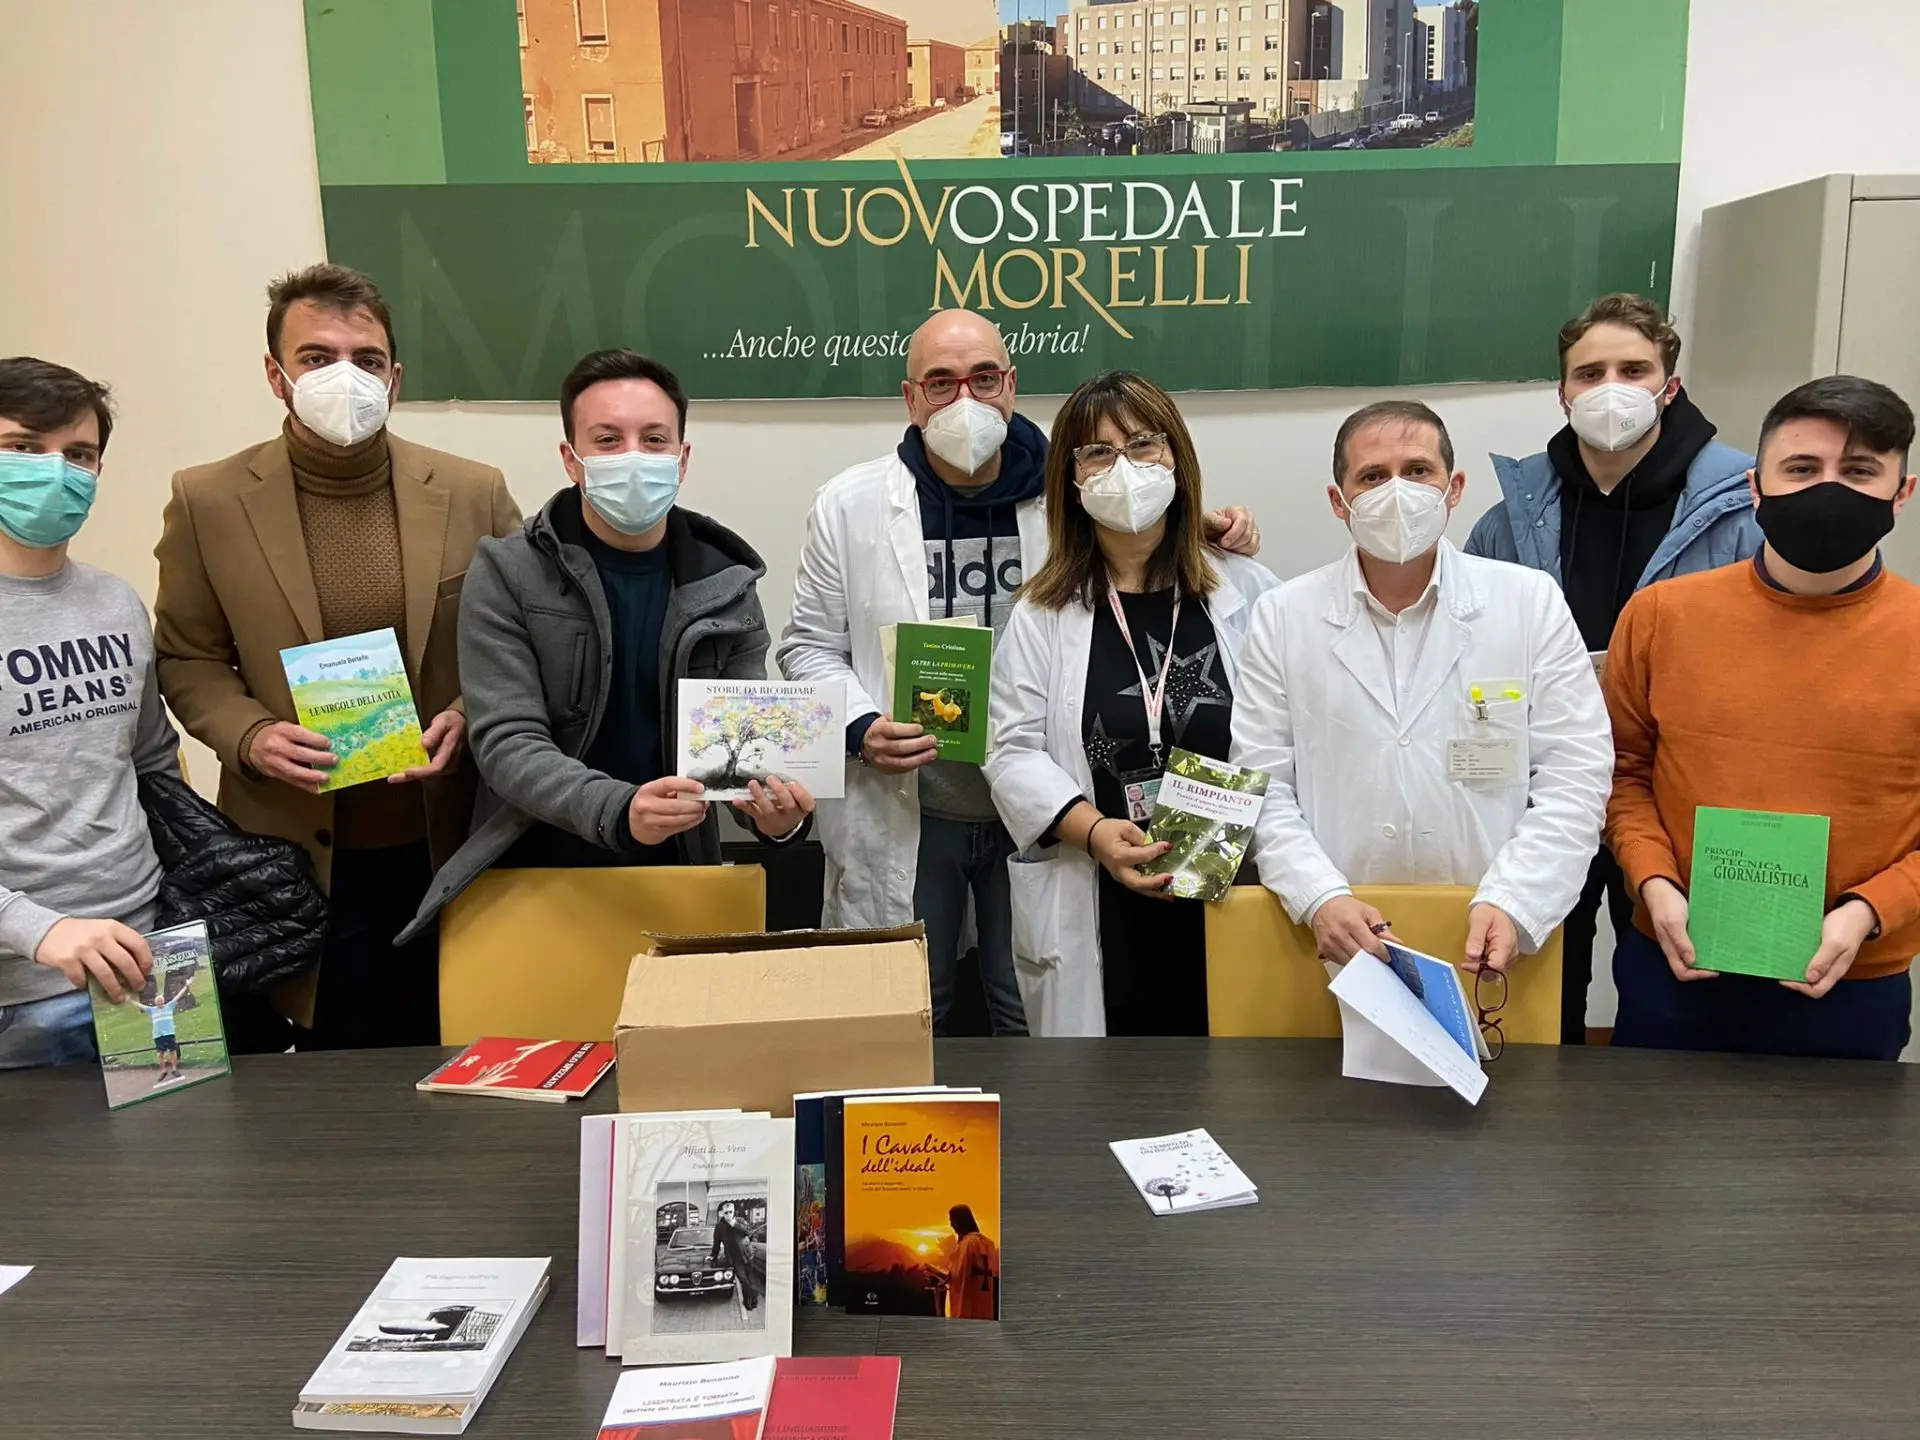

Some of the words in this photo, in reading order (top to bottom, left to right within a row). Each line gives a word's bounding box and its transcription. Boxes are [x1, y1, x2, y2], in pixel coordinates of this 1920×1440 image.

[928, 242, 1253, 340] MORELLI
[0, 633, 134, 687] OMMY
[320, 697, 356, 714] VIRGOLE
[356, 693, 382, 707] DELLA
[382, 689, 402, 701] VITA
[706, 686, 741, 694] STORIE
[744, 686, 758, 694] DA
[760, 686, 816, 695] RICORDARE
[9, 711, 82, 737] AMERICAN
[86, 700, 138, 720] ORIGINAL
[1172, 780, 1184, 790] IL
[1187, 783, 1253, 806] RIMPIANTO
[1705, 846, 1744, 857] PRINCIPI
[1720, 857, 1782, 871] TECNICA
[1714, 865, 1809, 888] GIORNALISTICA
[862, 1134, 868, 1156] I
[875, 1133, 967, 1155] Cavalieri
[861, 1157, 936, 1174] dell'ideale
[659, 1379, 698, 1388] Maurizio
[700, 1374, 740, 1384] Bonanno
